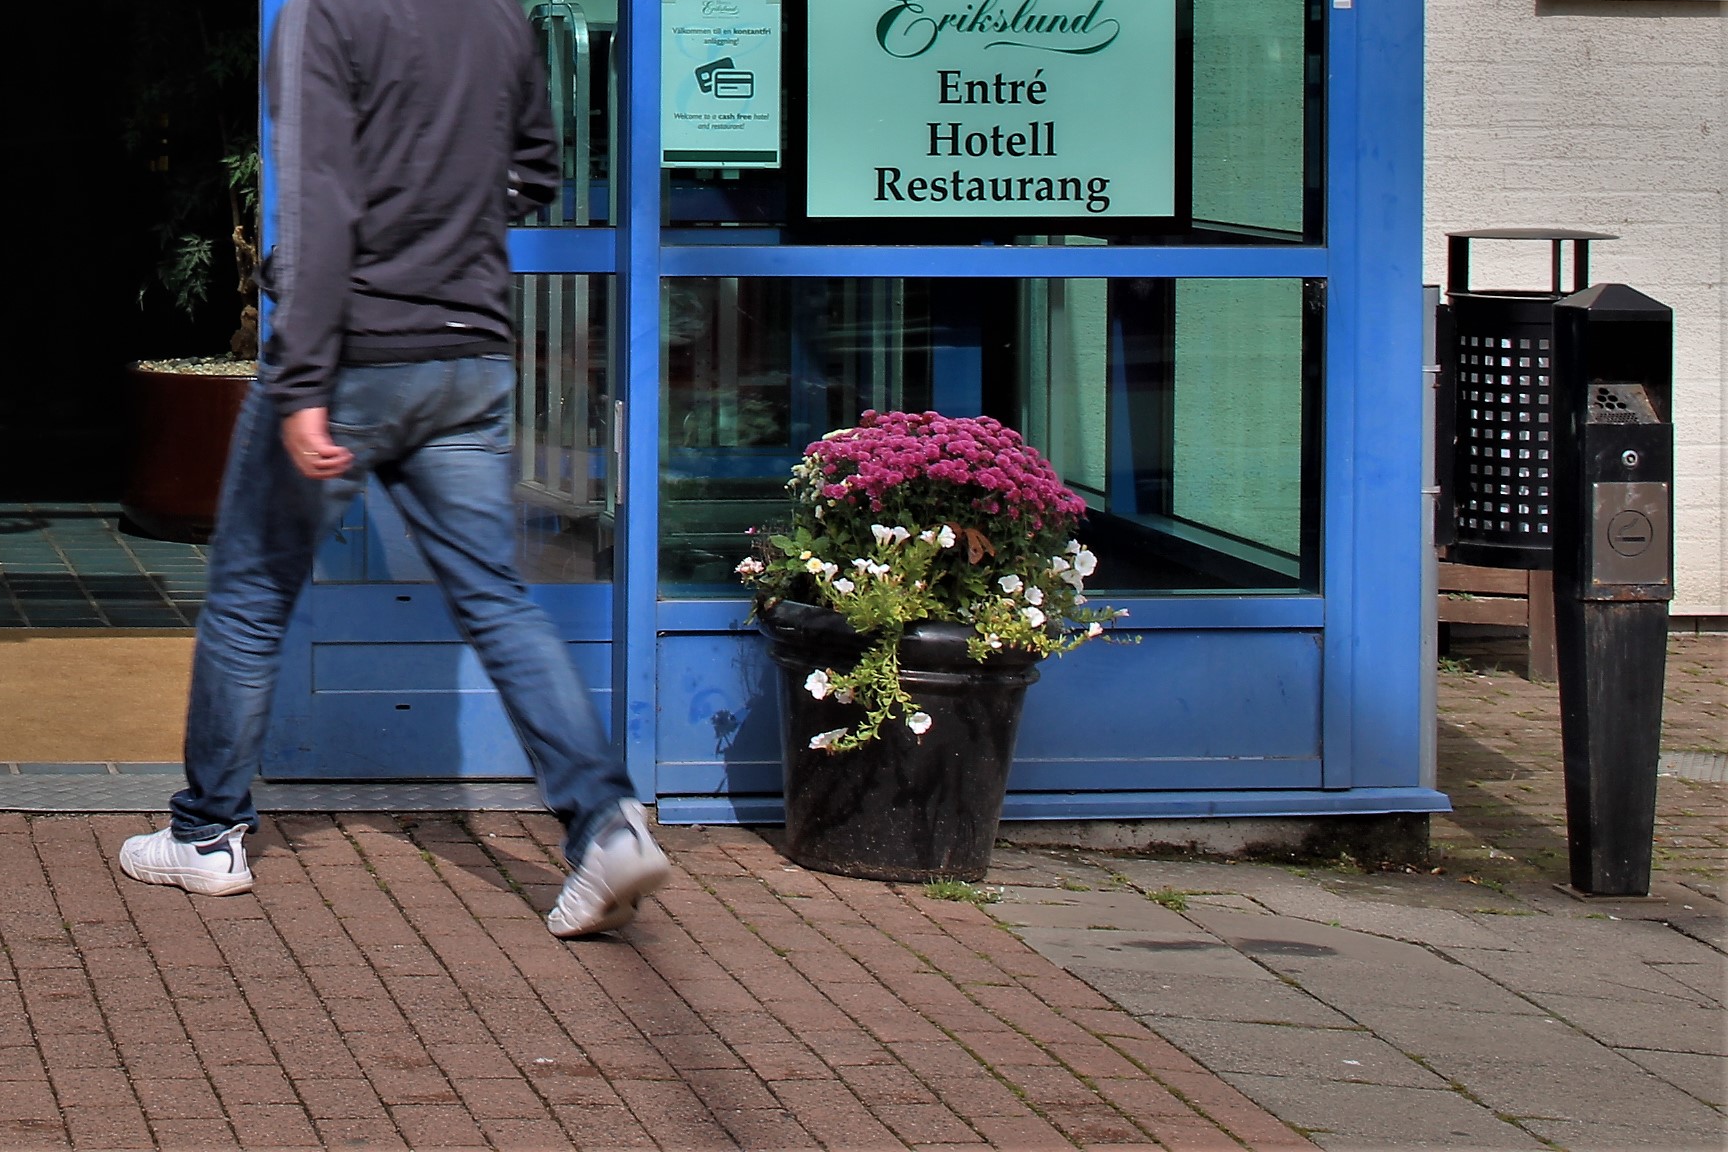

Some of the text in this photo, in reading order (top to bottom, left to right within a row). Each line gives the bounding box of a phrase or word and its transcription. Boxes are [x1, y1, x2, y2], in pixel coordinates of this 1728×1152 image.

[672, 27, 712, 35] Välkommen
[733, 27, 772, 35] kontantfri
[936, 68, 1048, 105] Entré
[674, 112, 703, 120] Welcome
[718, 112, 735, 120] cash
[737, 112, 753, 120] free
[754, 112, 770, 120] hotel
[925, 120, 1058, 158] Hotell
[873, 166, 1112, 214] Restaurang
